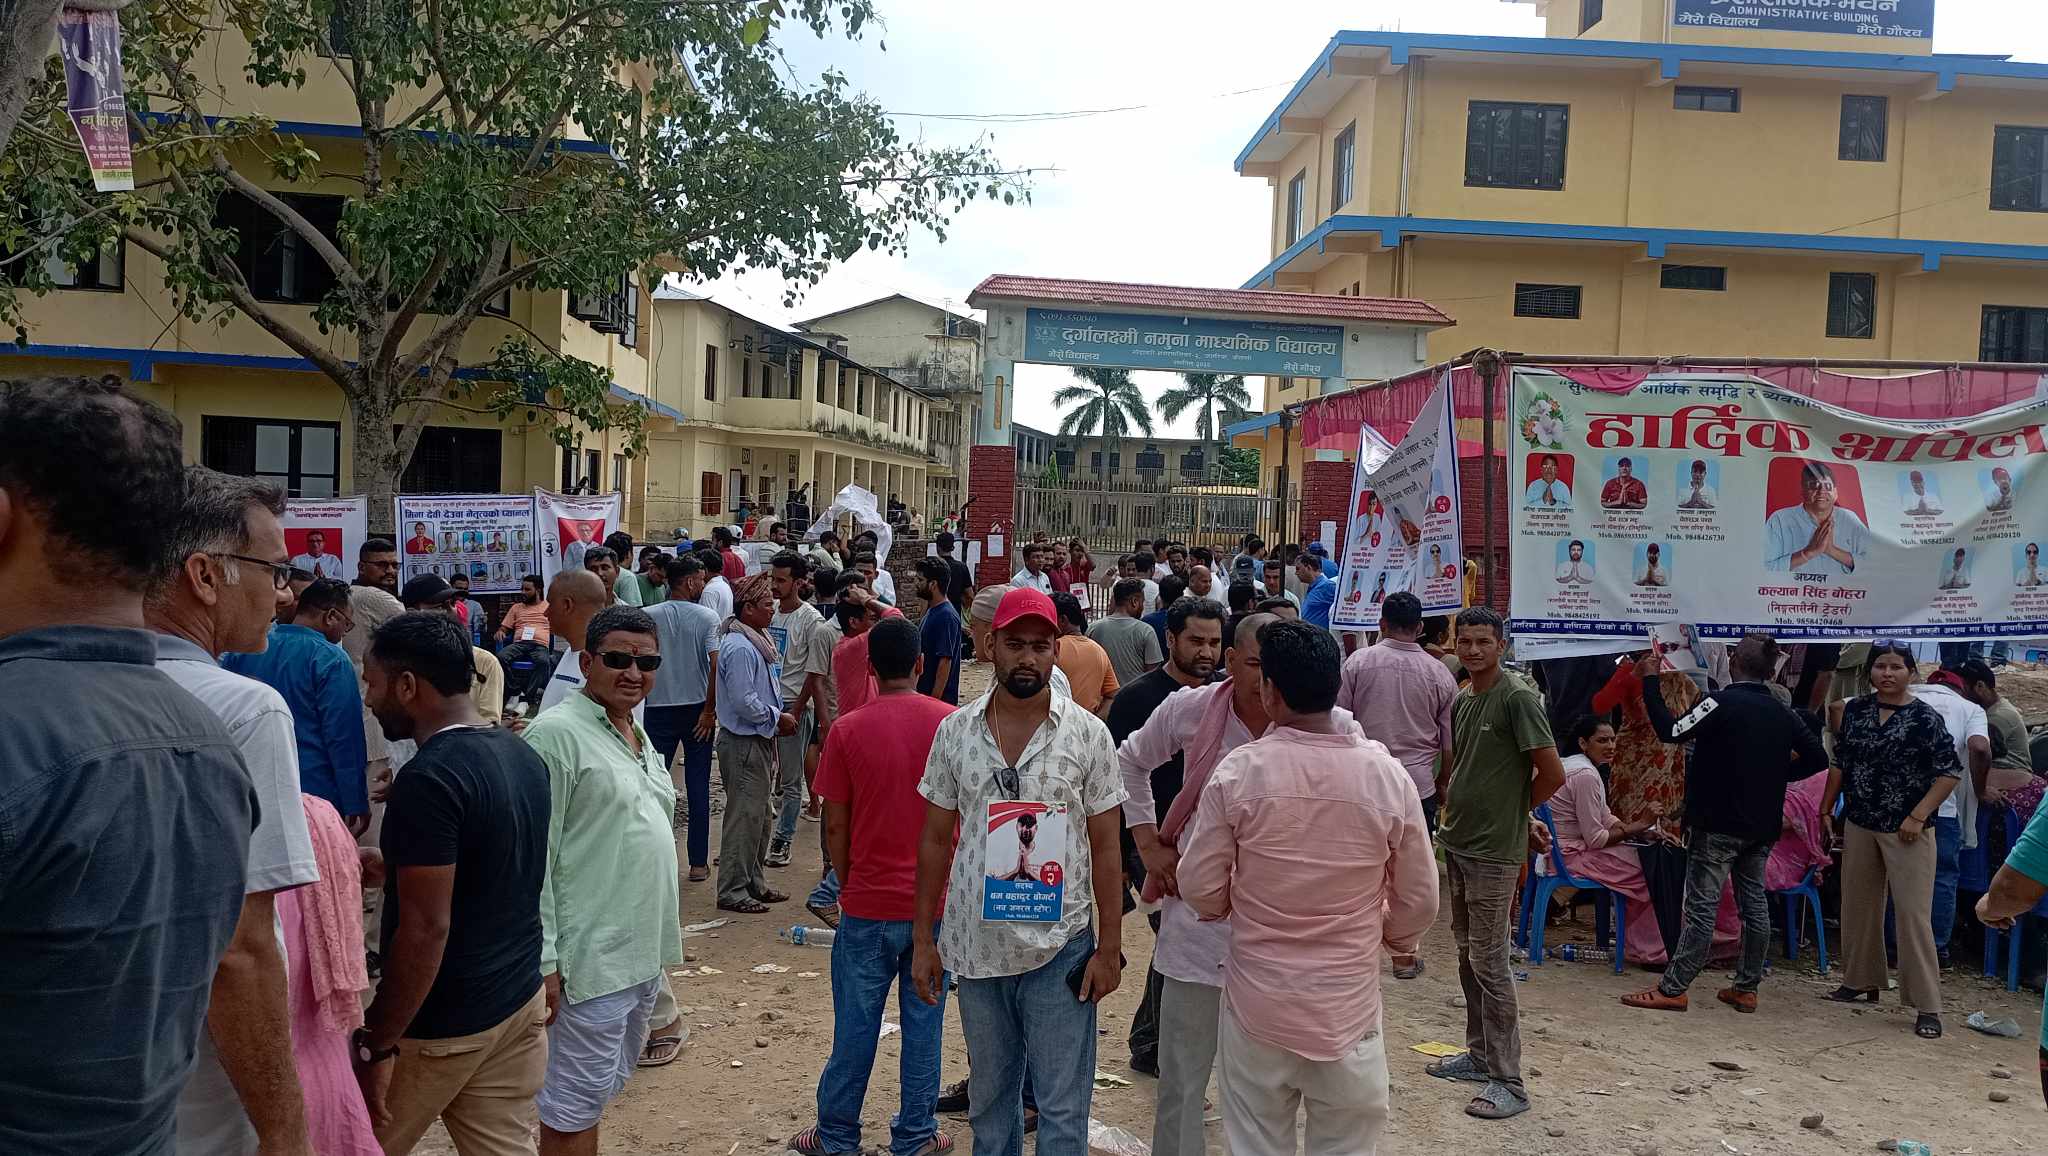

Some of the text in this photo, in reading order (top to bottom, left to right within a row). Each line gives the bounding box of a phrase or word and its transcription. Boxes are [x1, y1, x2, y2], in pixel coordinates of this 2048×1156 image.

[1678, 12, 1760, 27] मेरो विद्यालय
[1856, 23, 1922, 37] मेरो गौरव
[1061, 326, 1337, 355] दुर्गालक्ष्मी नमुना माध्यमिक विद्यालय
[1048, 349, 1100, 361] मेरो विद्यालय
[1283, 361, 1299, 373] मेरो
[1640, 382, 1690, 396] आर्थिक
[1698, 383, 1740, 400] समृद्धि
[1585, 403, 1813, 457] हार्दिक
[1793, 573, 1828, 583] अध्यक्ष
[1758, 585, 1867, 599] कल्यान सिंह बोहरा
[1047, 873, 1055, 886] २
